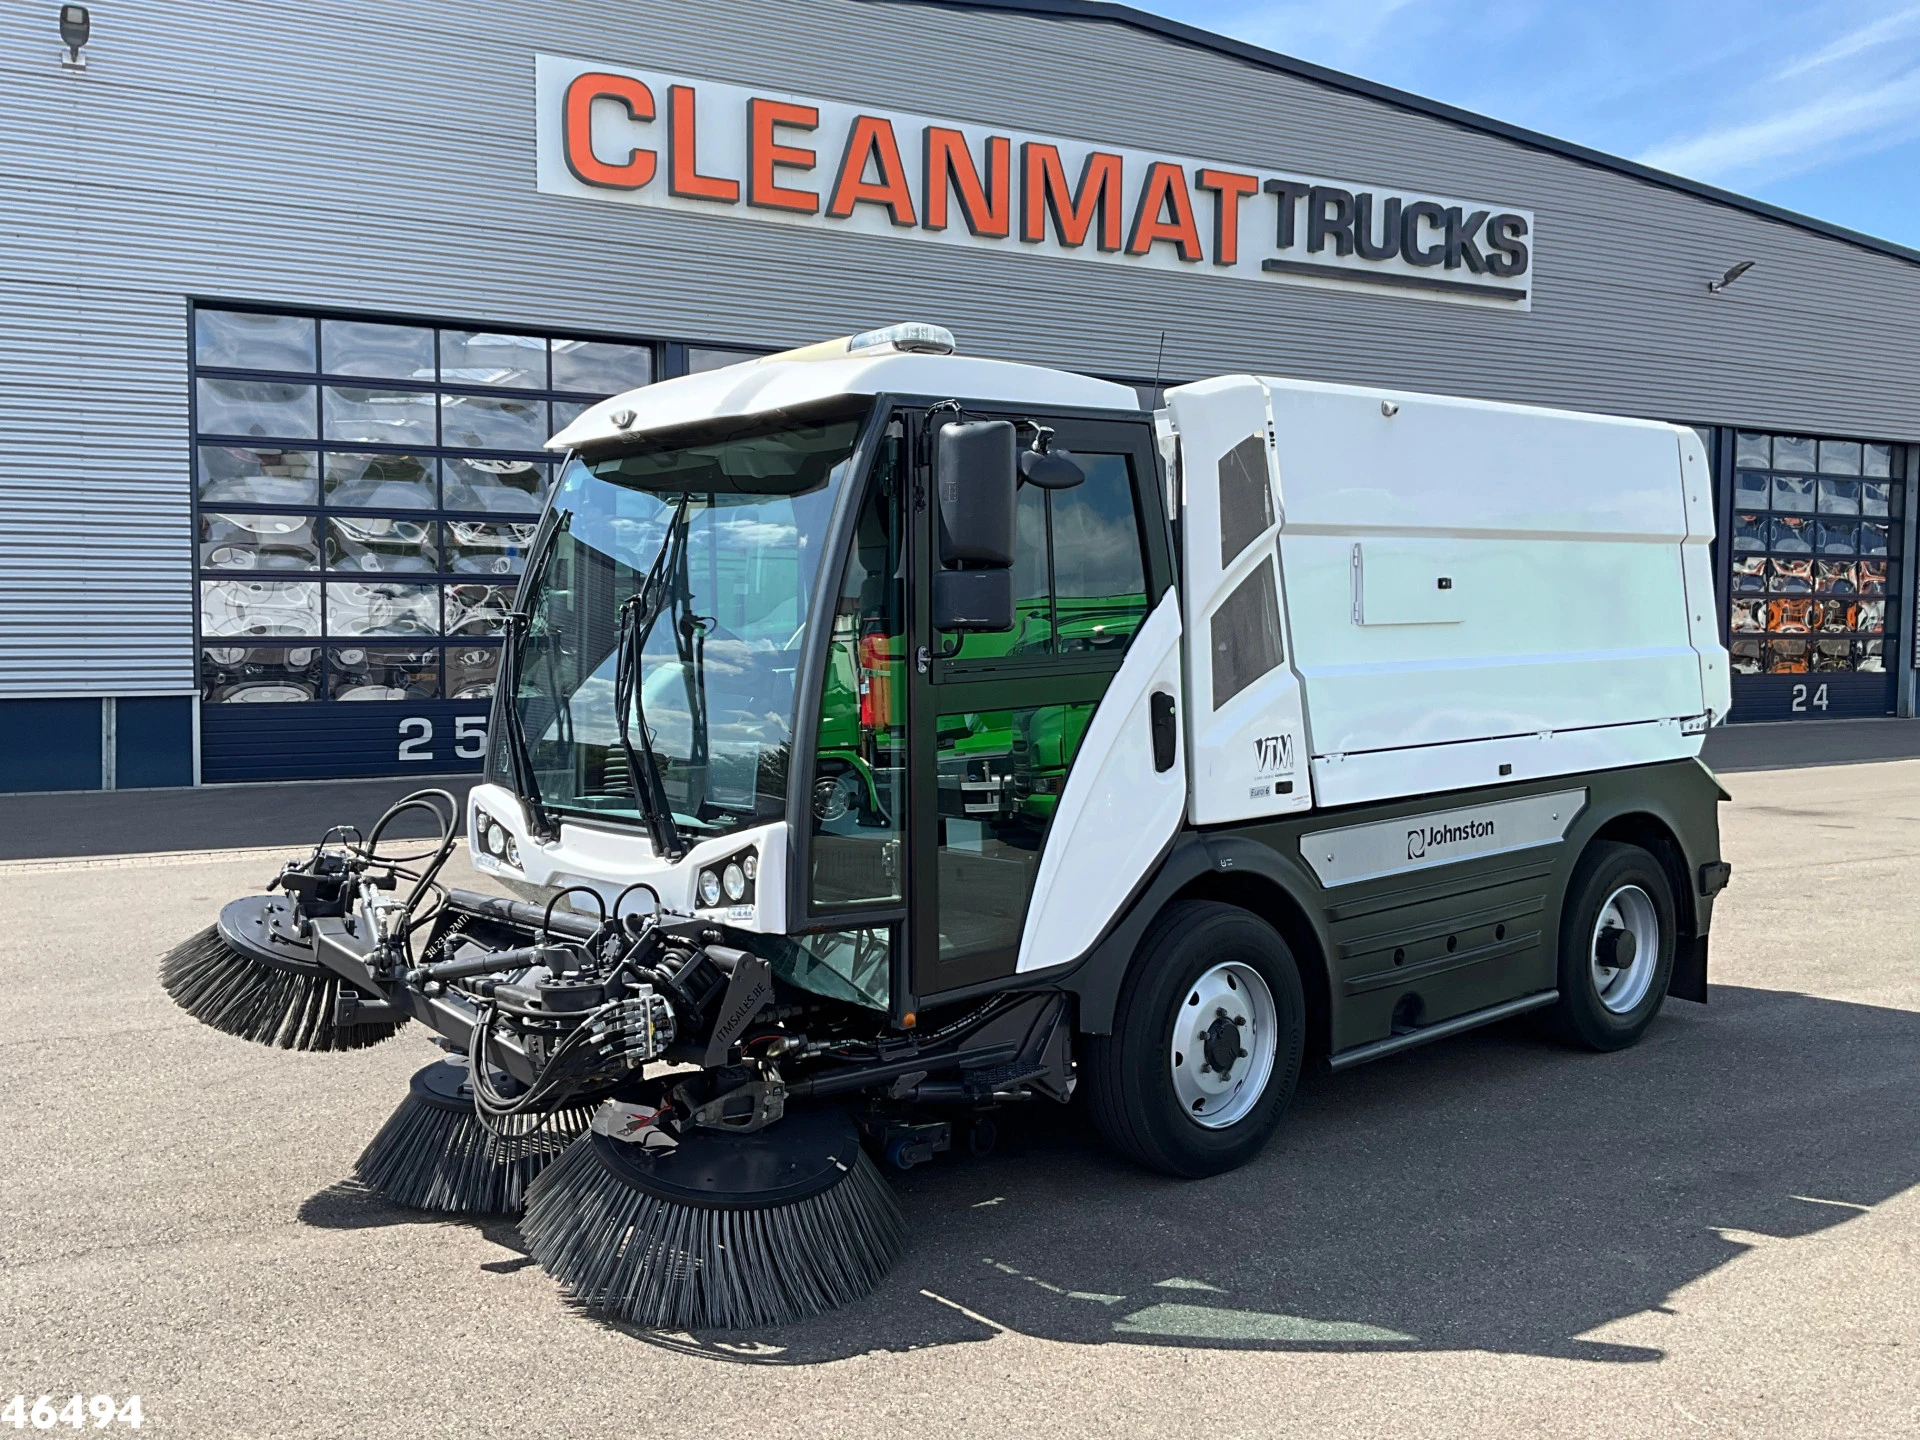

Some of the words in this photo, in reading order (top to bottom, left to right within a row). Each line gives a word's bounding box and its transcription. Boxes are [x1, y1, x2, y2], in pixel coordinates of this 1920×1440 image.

[562, 72, 1258, 265] CLEANMAT
[1264, 179, 1528, 278] TRUCKS
[1792, 683, 1829, 712] 24
[1253, 733, 1294, 773] VTM
[1427, 820, 1494, 847] Johnston
